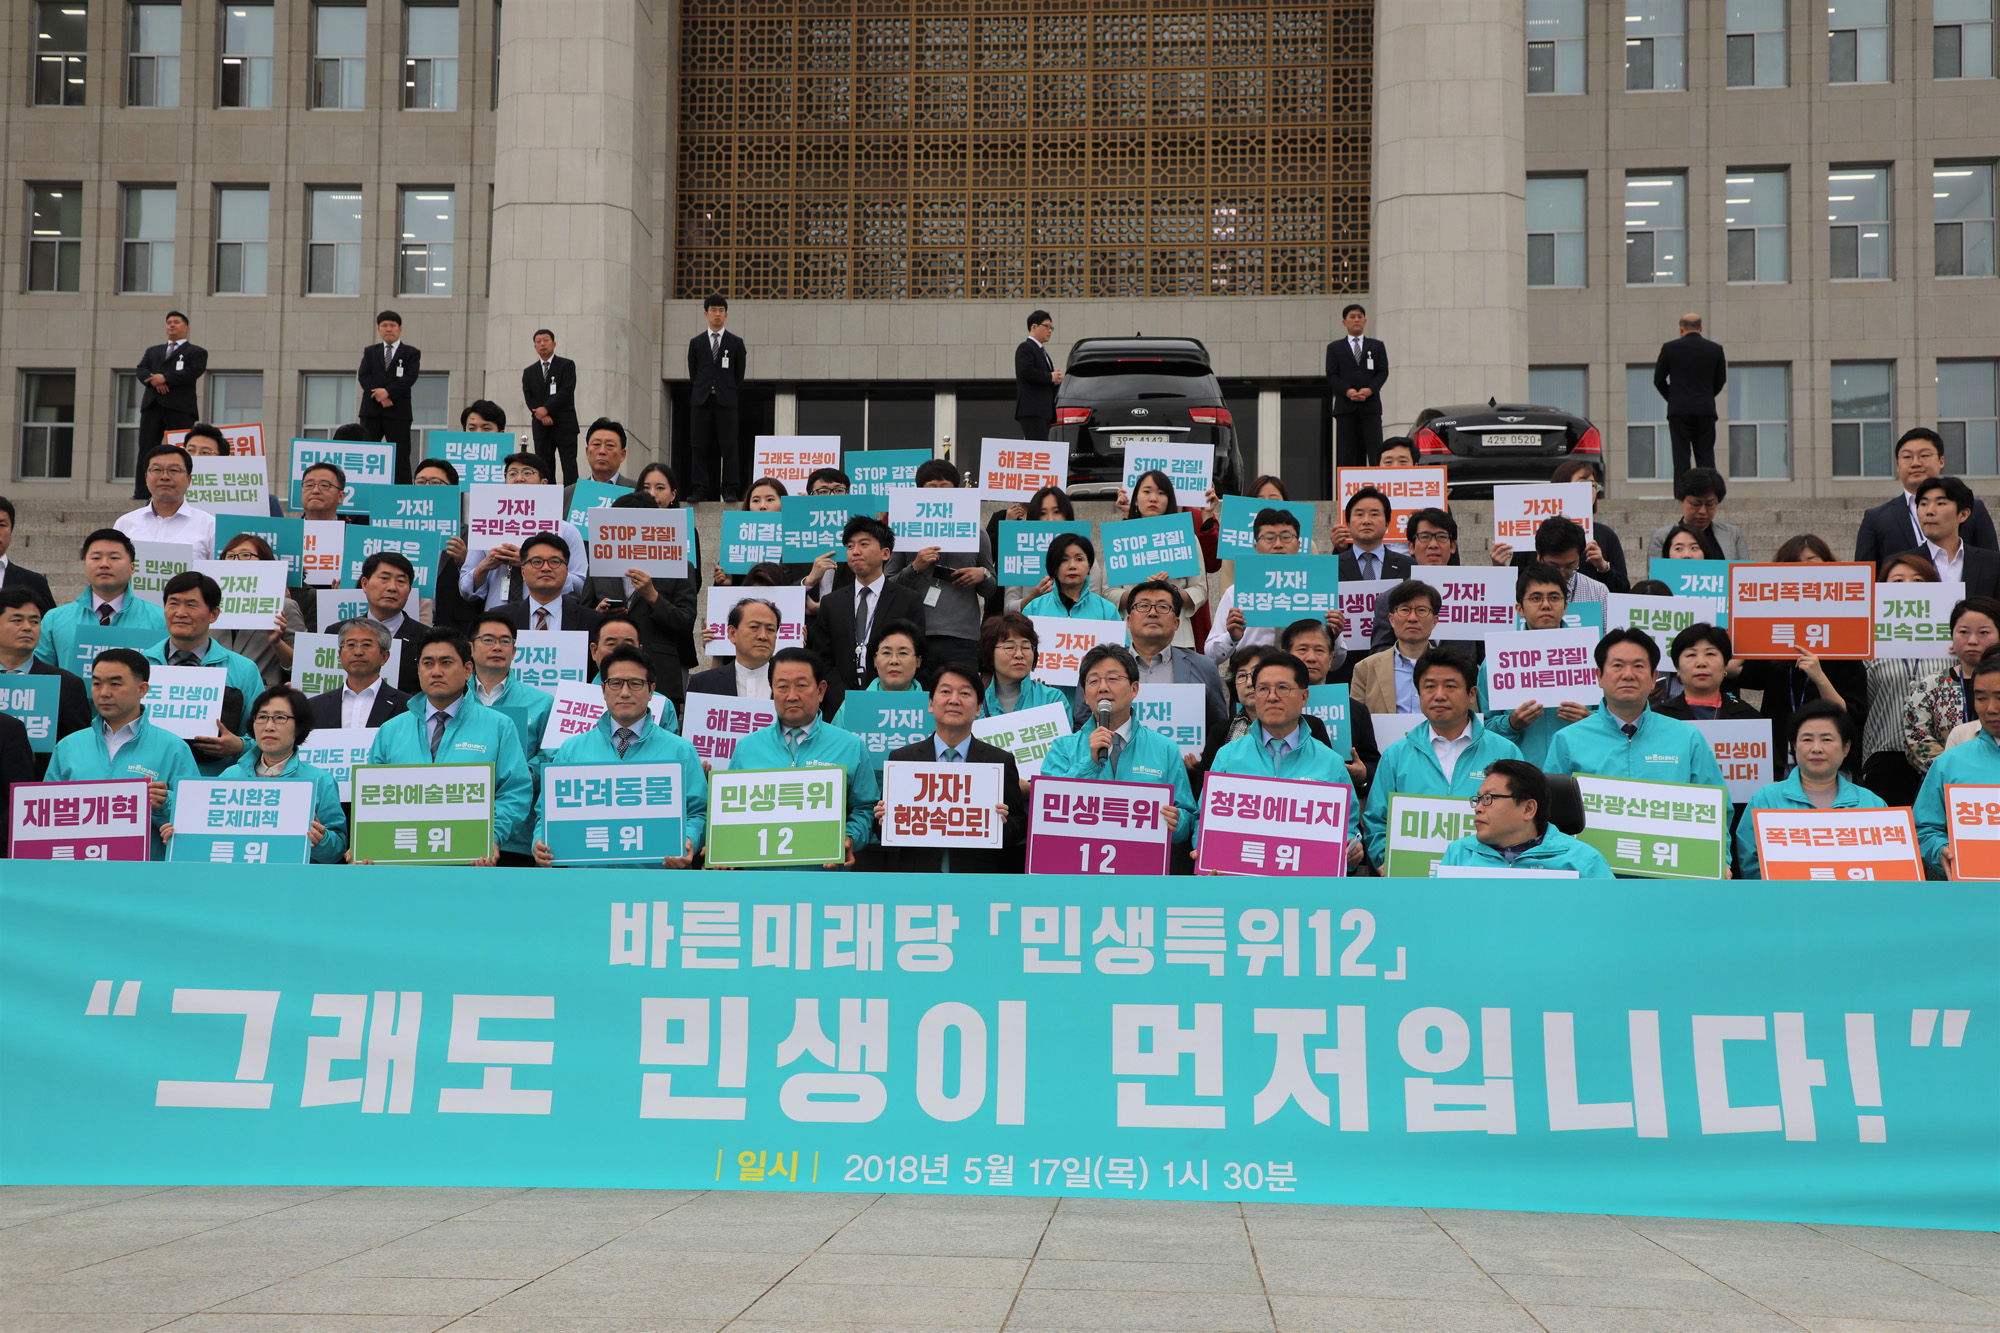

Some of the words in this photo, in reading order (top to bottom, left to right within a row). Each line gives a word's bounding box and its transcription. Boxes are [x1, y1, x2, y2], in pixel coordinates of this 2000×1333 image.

[1511, 435, 1536, 444] 0520
[445, 442, 497, 461] 민생에
[758, 452, 794, 465] 그래도
[799, 452, 836, 465] 민생이
[998, 450, 1051, 470] 해결은
[855, 466, 888, 481] STOP
[891, 465, 918, 480] 갑질
[1134, 458, 1168, 472] STOP
[1171, 459, 1203, 474] 갑질!
[191, 473, 218, 486] 래도
[223, 473, 263, 486] 민생이
[849, 483, 867, 495] GO
[185, 489, 258, 503] 먼저입니다!
[397, 500, 434, 516] 가자!
[497, 499, 535, 516] 가자!
[915, 502, 953, 518] 가자!
[1523, 498, 1562, 515] 가자!
[471, 518, 560, 536] 국민속으로!
[810, 510, 848, 527] 가자!
[600, 526, 636, 541] STOP
[641, 526, 676, 542] 갑질!
[891, 522, 977, 538] 바른미래로!
[1017, 532, 1059, 552] 민생
[1112, 536, 1147, 553] STOP
[1151, 529, 1185, 547] 갑질!
[594, 545, 613, 560] GO
[617, 544, 683, 561] 바른미래!
[729, 544, 781, 565] 발빠르
[1109, 555, 1128, 570] GO
[1132, 545, 1193, 567] 바른미래!
[145, 560, 188, 576] 민생이
[1004, 555, 1040, 574] 빠른
[220, 576, 258, 593] 가자!
[1265, 571, 1307, 589] 가자!
[1680, 574, 1724, 593] 가자!
[1237, 592, 1335, 612] 현장속으로!
[1443, 583, 1486, 601] 가자!
[1738, 582, 1866, 602] 젠더폭력제로
[1437, 605, 1514, 624] 른미래로!
[1883, 599, 1930, 619] 가자!
[1629, 608, 1695, 631] 민생에
[1055, 633, 1096, 651] 가자!
[1771, 624, 1796, 648] 특
[1805, 624, 1831, 648] 위
[514, 647, 557, 665] 가자!
[1499, 648, 1542, 669] STOP
[1547, 647, 1588, 666] 갑질!
[1493, 672, 1515, 690] GO
[1521, 666, 1597, 688] 바른미래!
[169, 686, 219, 702] 민생이
[556, 699, 604, 721] 그래도
[878, 709, 924, 729] 가자!
[706, 708, 774, 734] 해결은
[1018, 721, 1059, 744] 갑질!
[299, 748, 344, 764] 그래도
[1645, 753, 1679, 765] 바른미래당
[1714, 742, 1767, 760] 민생이
[209, 788, 281, 806] 도시환경
[361, 782, 485, 806] 문화예술발전
[554, 775, 673, 808] 반려동물
[721, 781, 834, 813] 민생특위
[913, 772, 971, 804] 가자!
[23, 794, 138, 827] 재벌개혁
[1043, 793, 1160, 830] 민생특위
[1210, 790, 1340, 828] 청정에너지
[1582, 792, 1716, 824] 관광산업발전
[207, 810, 279, 828] 문제대책
[893, 803, 990, 838] 현장속으로!
[394, 828, 418, 854] 특
[428, 827, 451, 852] 위
[585, 828, 610, 852] 특
[619, 826, 644, 851] 위
[757, 829, 767, 856] 1
[777, 826, 793, 855] 2
[1766, 825, 1907, 847] 폭력근절대책
[244, 841, 269, 863] 위
[1079, 843, 1089, 871] 1
[1100, 844, 1116, 873] 2
[1240, 840, 1266, 868] 특
[1276, 845, 1301, 871] 위
[1615, 837, 1642, 864] 특
[1652, 841, 1679, 868] 위
[608, 900, 959, 972] 바른미래당
[638, 995, 1027, 1126] 민생이
[736, 1149, 798, 1183] 일시
[844, 1152, 949, 1186] 2018년
[963, 1153, 1014, 1188] 5월
[1029, 1155, 1149, 1192] 17일(목)
[1162, 1160, 1210, 1191] 1시
[1223, 1162, 1298, 1192] 30분
